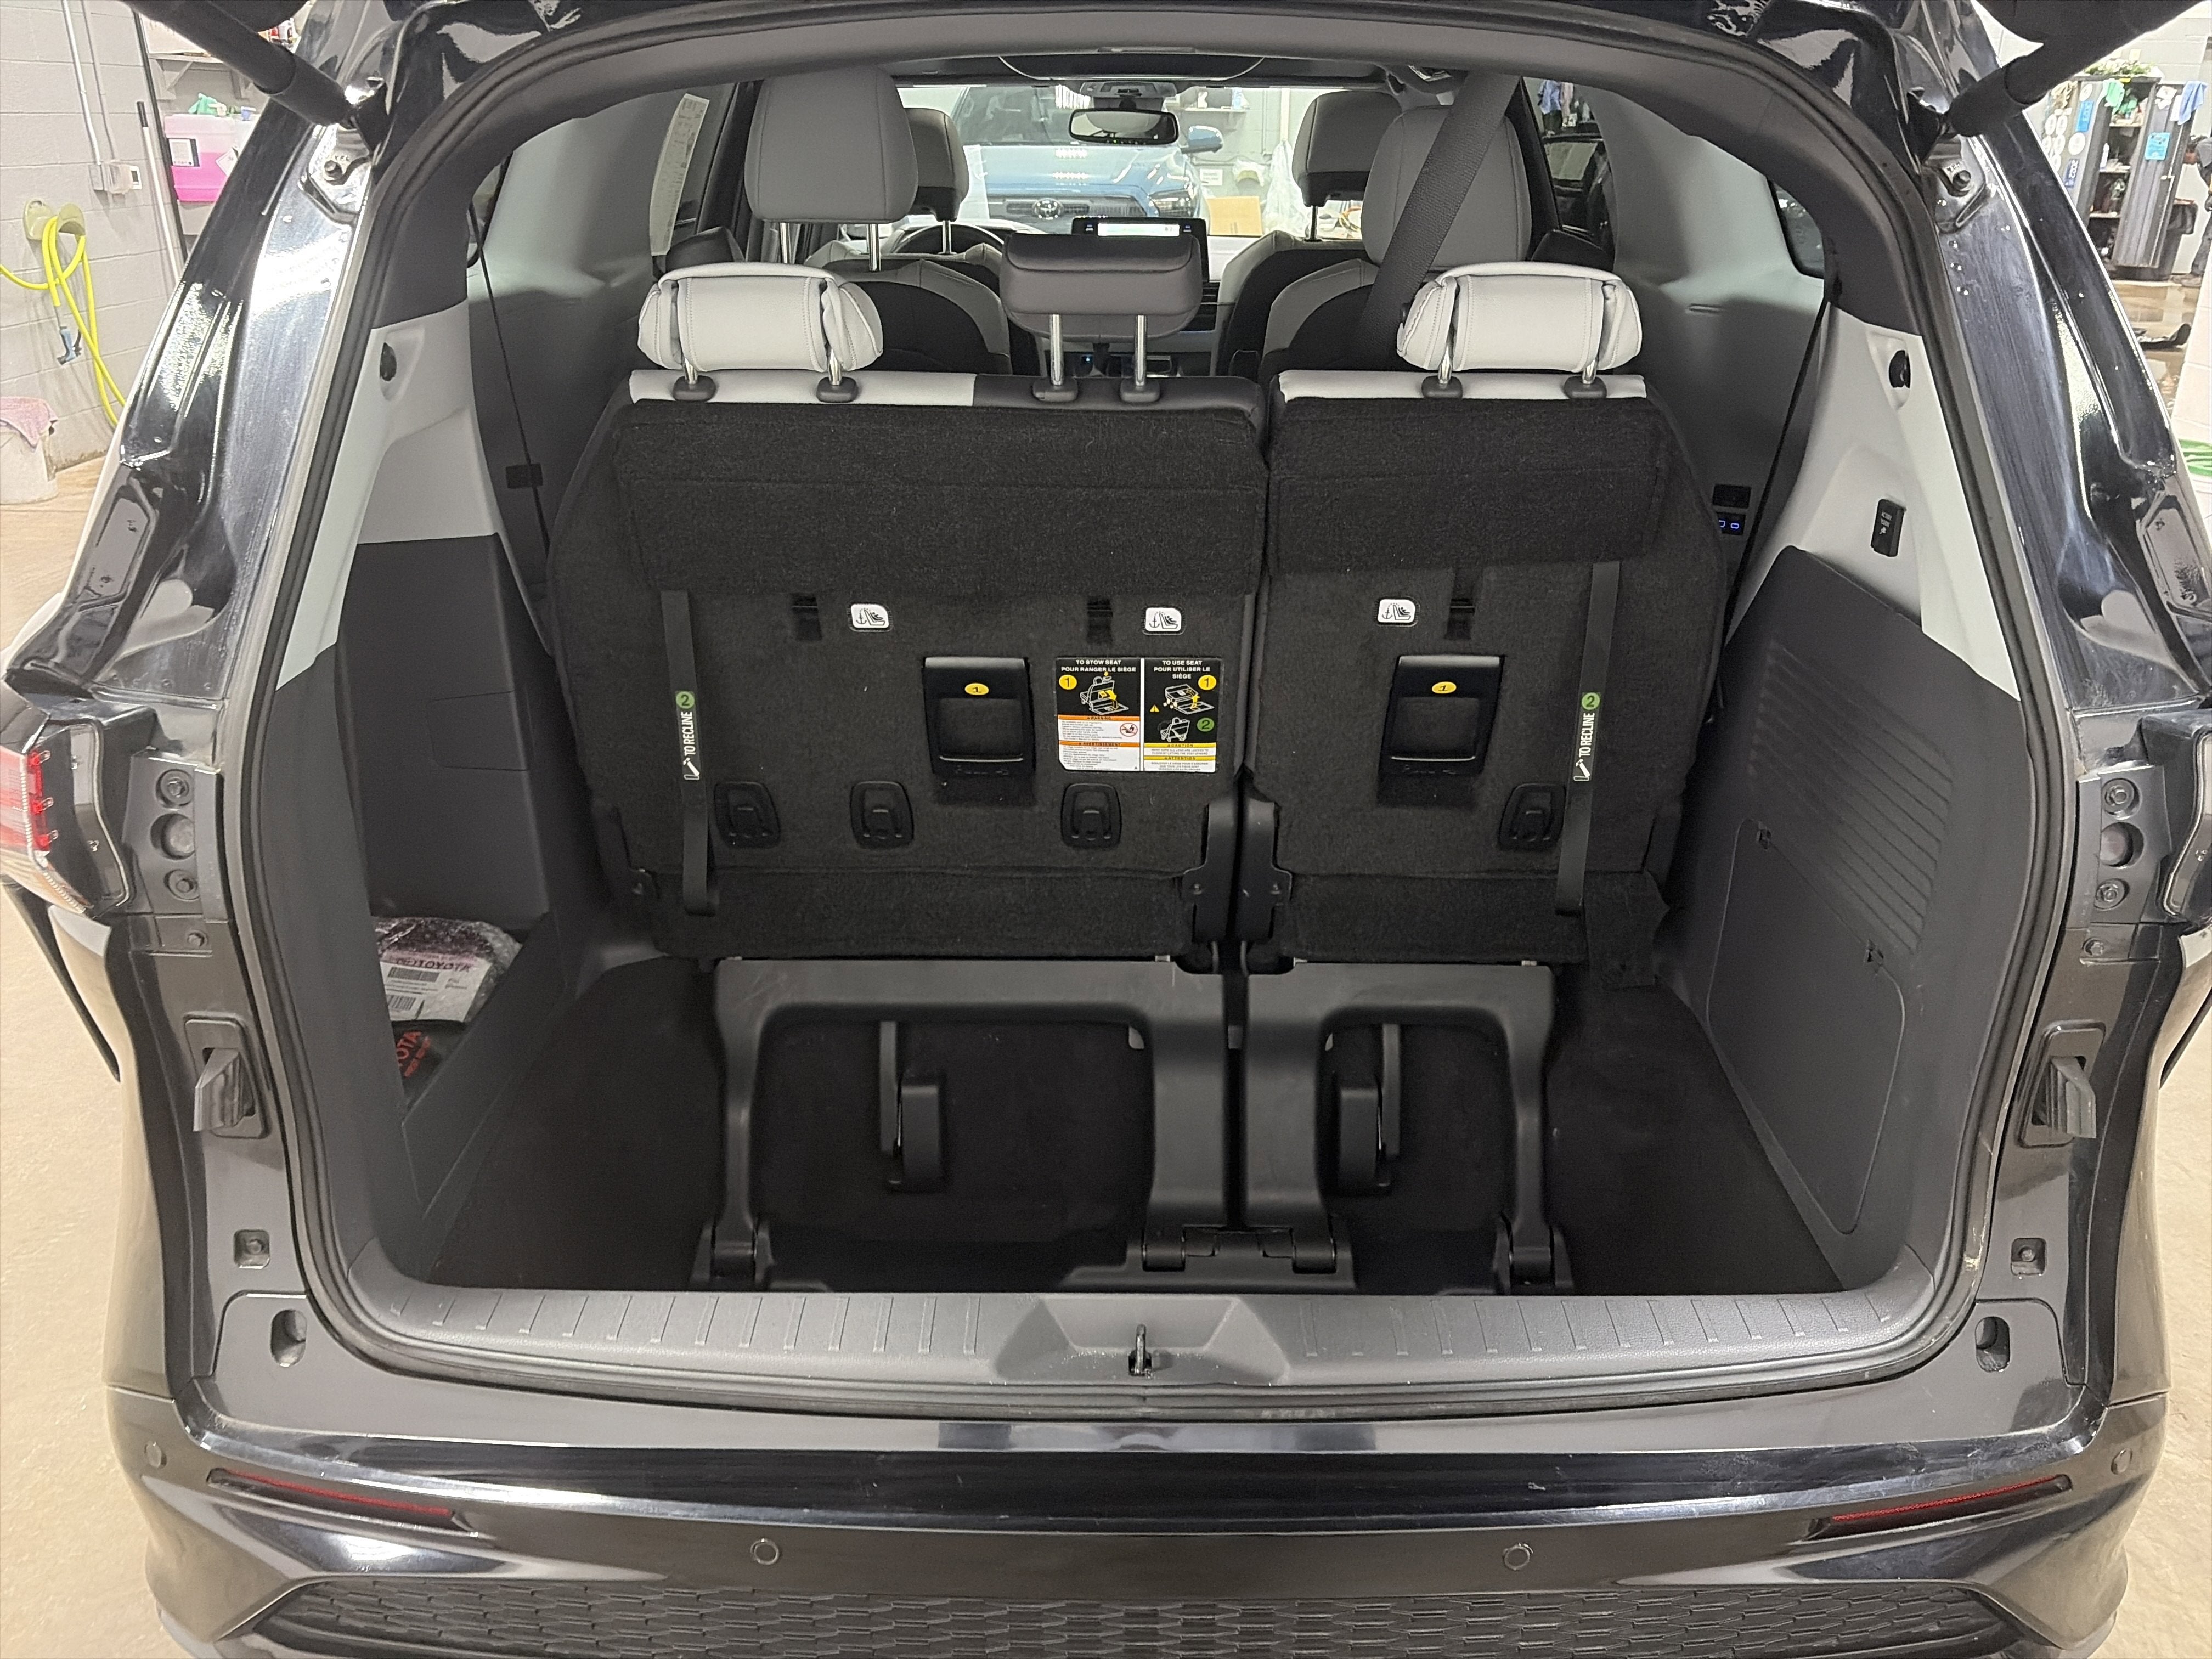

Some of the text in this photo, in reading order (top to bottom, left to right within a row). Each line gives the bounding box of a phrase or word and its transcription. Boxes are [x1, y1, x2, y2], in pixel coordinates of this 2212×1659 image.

[1064, 677, 1070, 687] 1
[1204, 678, 1209, 688] 1
[680, 694, 690, 706] 2
[1585, 695, 1595, 708] 2
[1201, 719, 1210, 730] 2
[680, 711, 696, 756] TO RECLINE
[1578, 712, 1595, 758] TO RECLINE
[419, 958, 471, 973] TOYOTA
